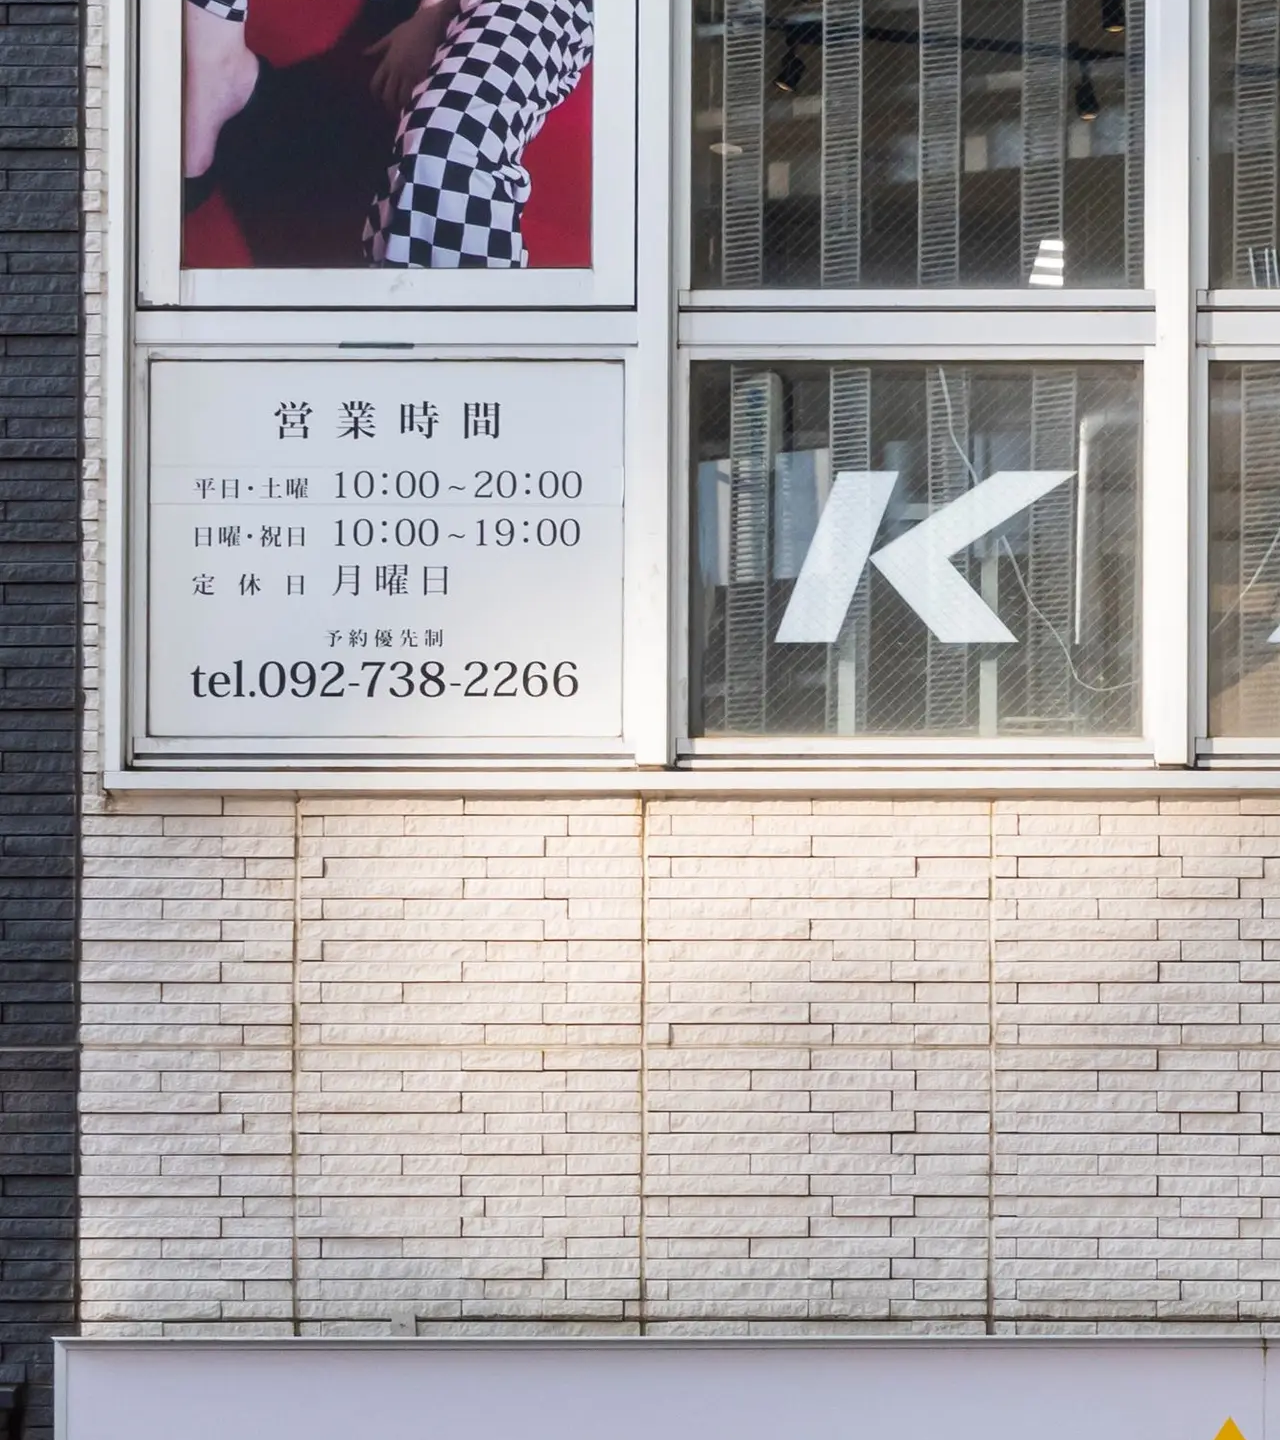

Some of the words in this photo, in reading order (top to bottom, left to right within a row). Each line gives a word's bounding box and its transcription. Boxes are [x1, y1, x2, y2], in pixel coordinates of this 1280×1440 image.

[274, 400, 503, 440] 営業時間
[192, 477, 310, 500] 平日・土曜
[193, 525, 307, 548] 日曜・祝日
[192, 573, 306, 597] 定休日
[332, 564, 450, 598] 月曜日
[323, 628, 445, 649] 予約優先制
[190, 660, 580, 699] tel.092-738-2266
